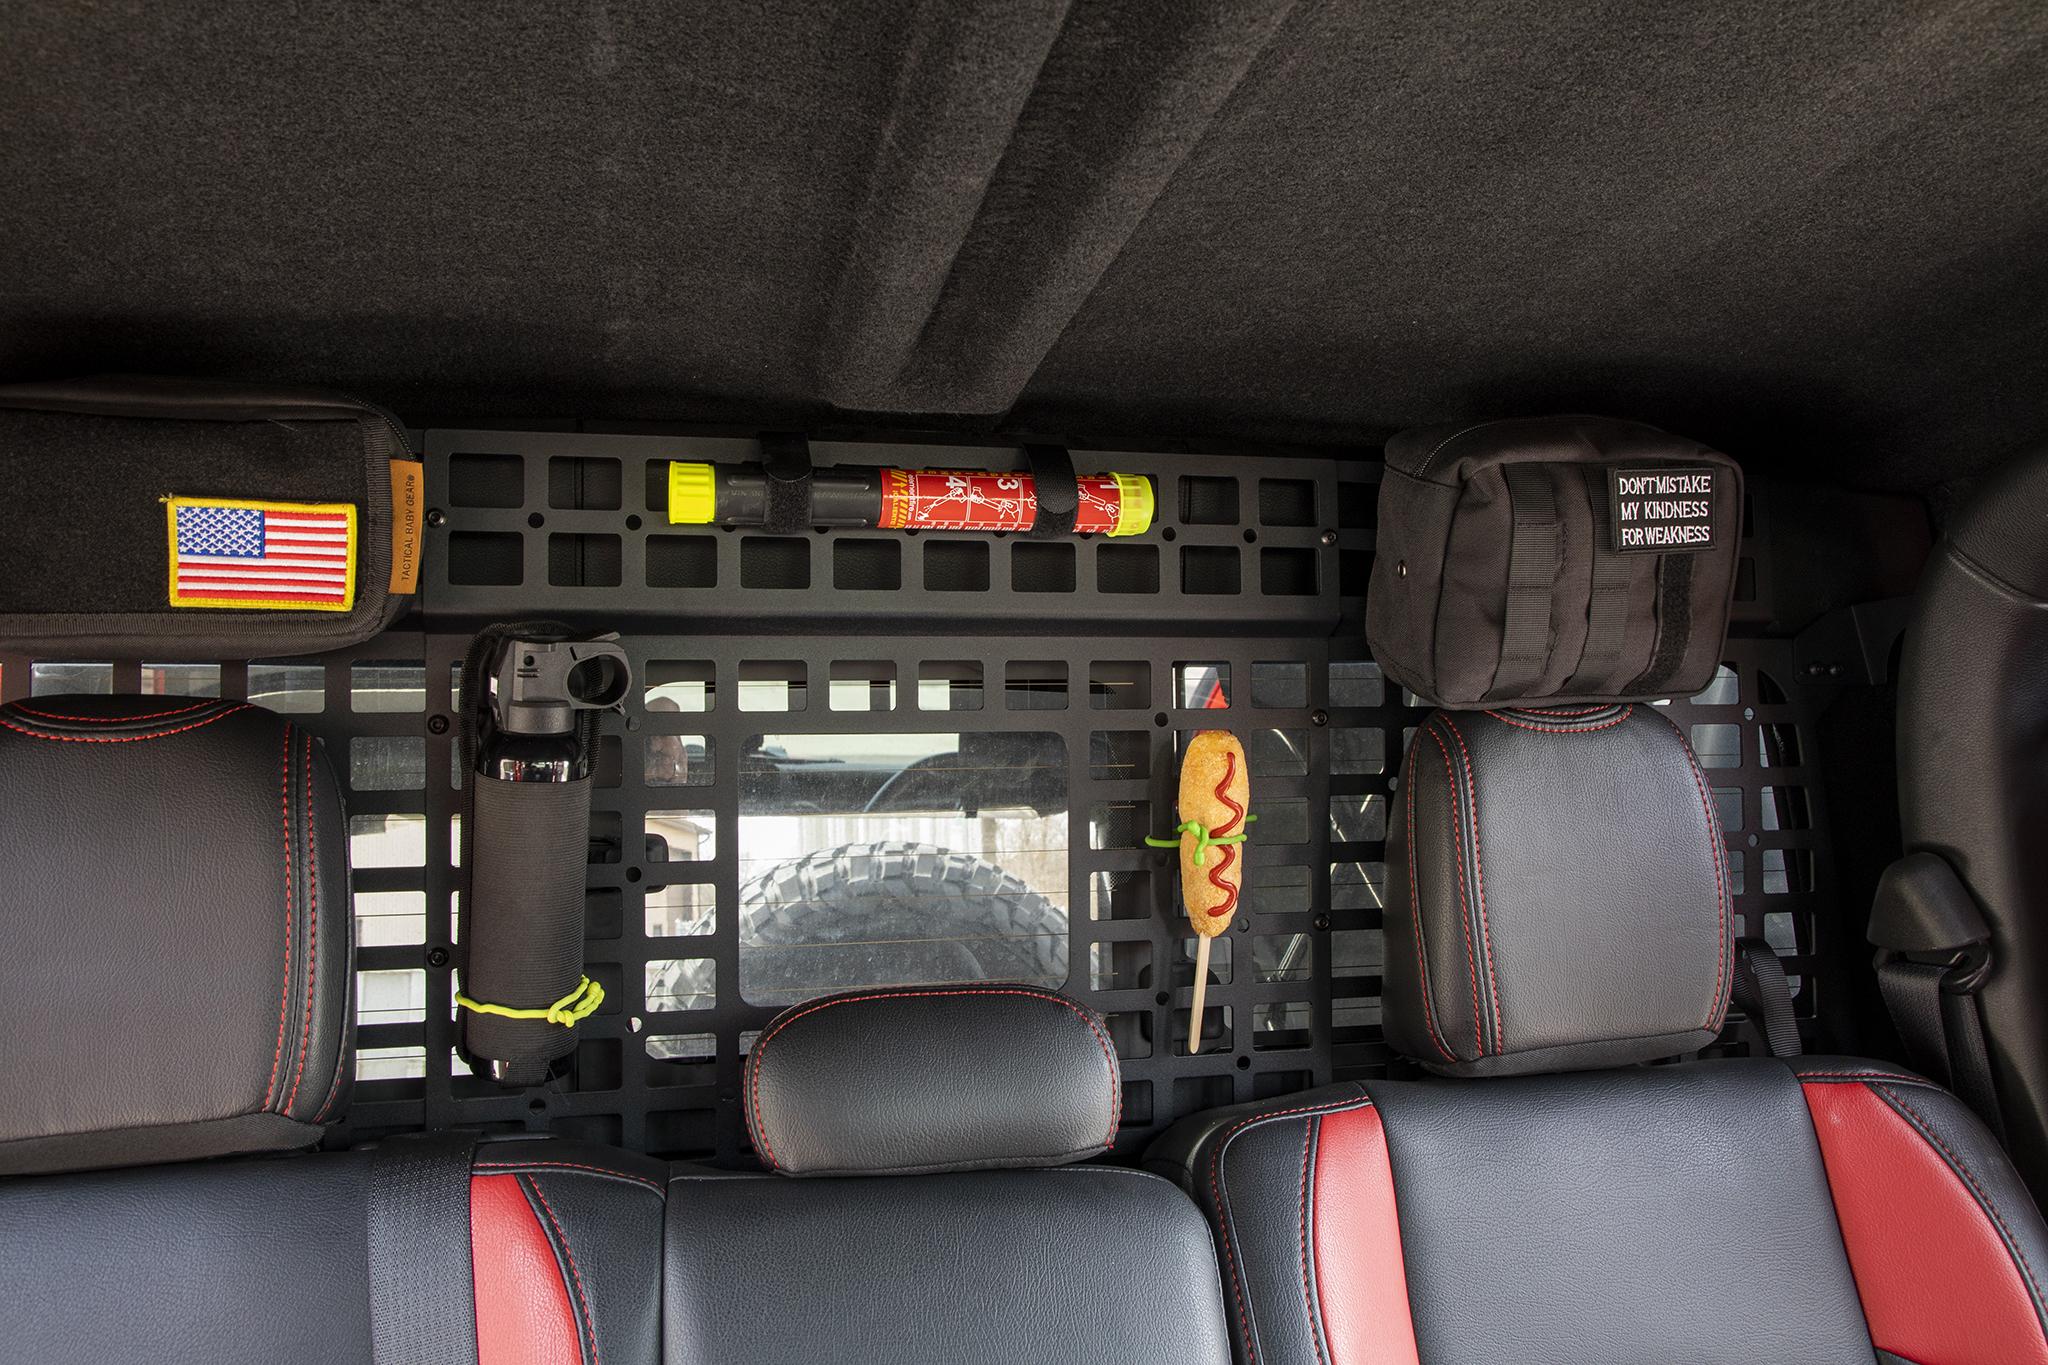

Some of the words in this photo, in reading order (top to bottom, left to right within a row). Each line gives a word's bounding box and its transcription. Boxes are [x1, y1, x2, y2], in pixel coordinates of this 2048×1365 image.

[945, 476, 967, 489] 4
[996, 478, 1019, 490] 3
[1619, 477, 1656, 495] DON'T
[1656, 475, 1711, 494] MISTAKE
[1621, 502, 1640, 521] MY
[1644, 501, 1709, 519] KINDNESS
[405, 510, 415, 535] BABY
[1621, 528, 1645, 546] FOR
[1645, 526, 1711, 545] WEAKNESS
[402, 538, 414, 581] TACTICAL
